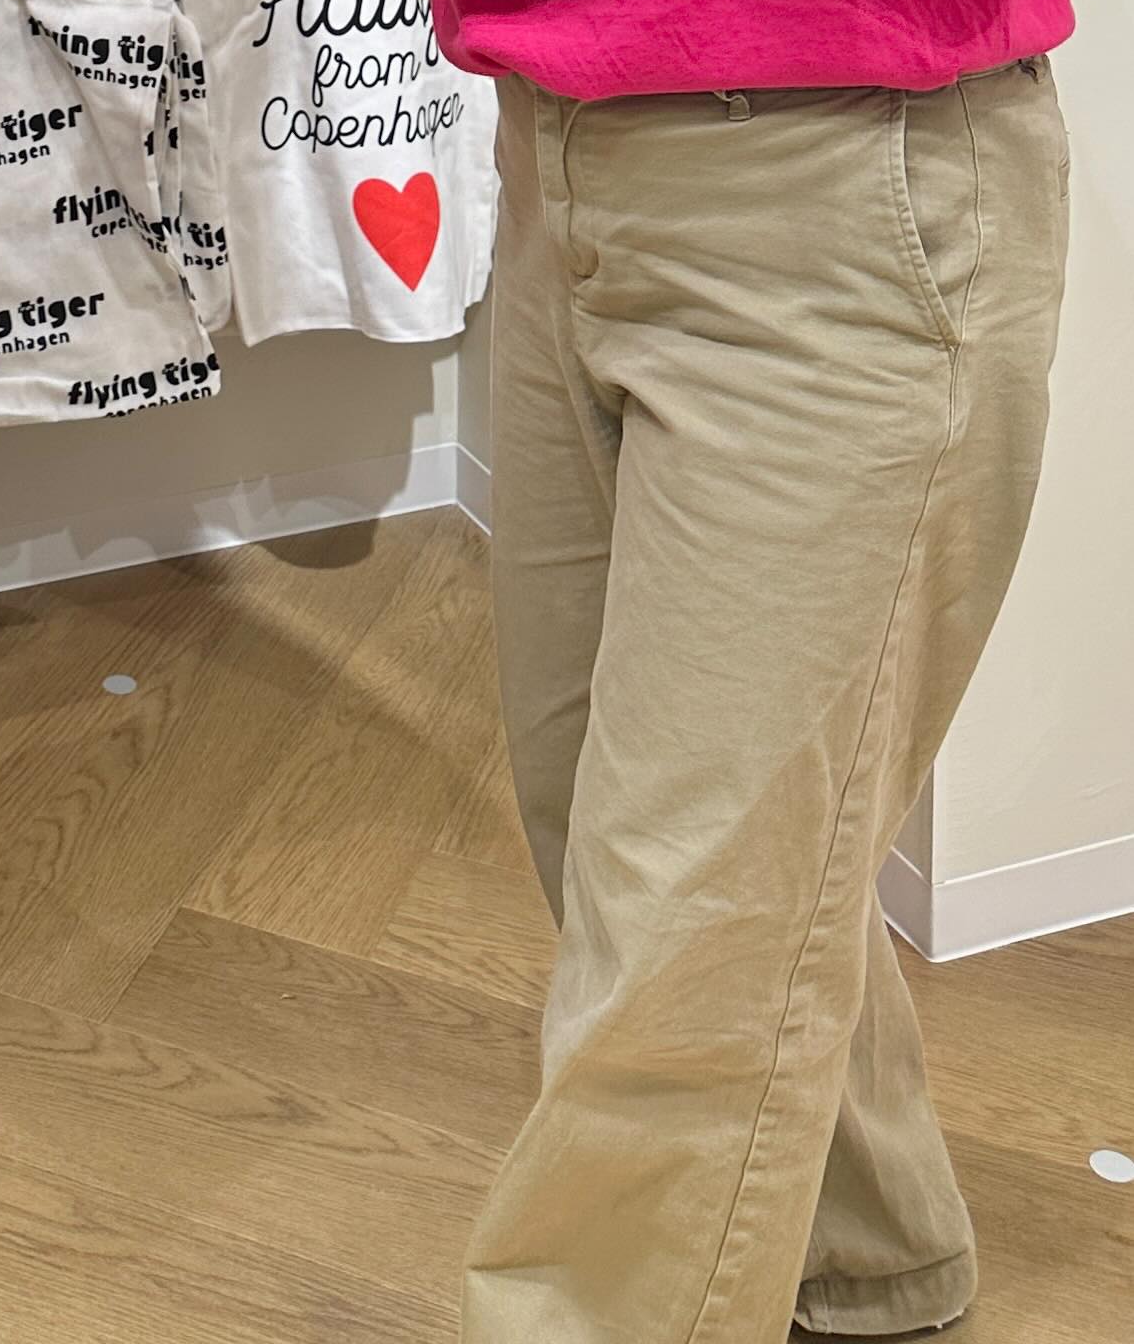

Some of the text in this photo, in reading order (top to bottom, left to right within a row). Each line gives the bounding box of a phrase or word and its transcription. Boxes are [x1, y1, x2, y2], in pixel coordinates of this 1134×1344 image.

[312, 44, 421, 108] from
[1, 104, 83, 142] tiger
[262, 92, 464, 158] Copenhagen
[18, 292, 105, 329] tiger
[68, 369, 157, 410] flying
